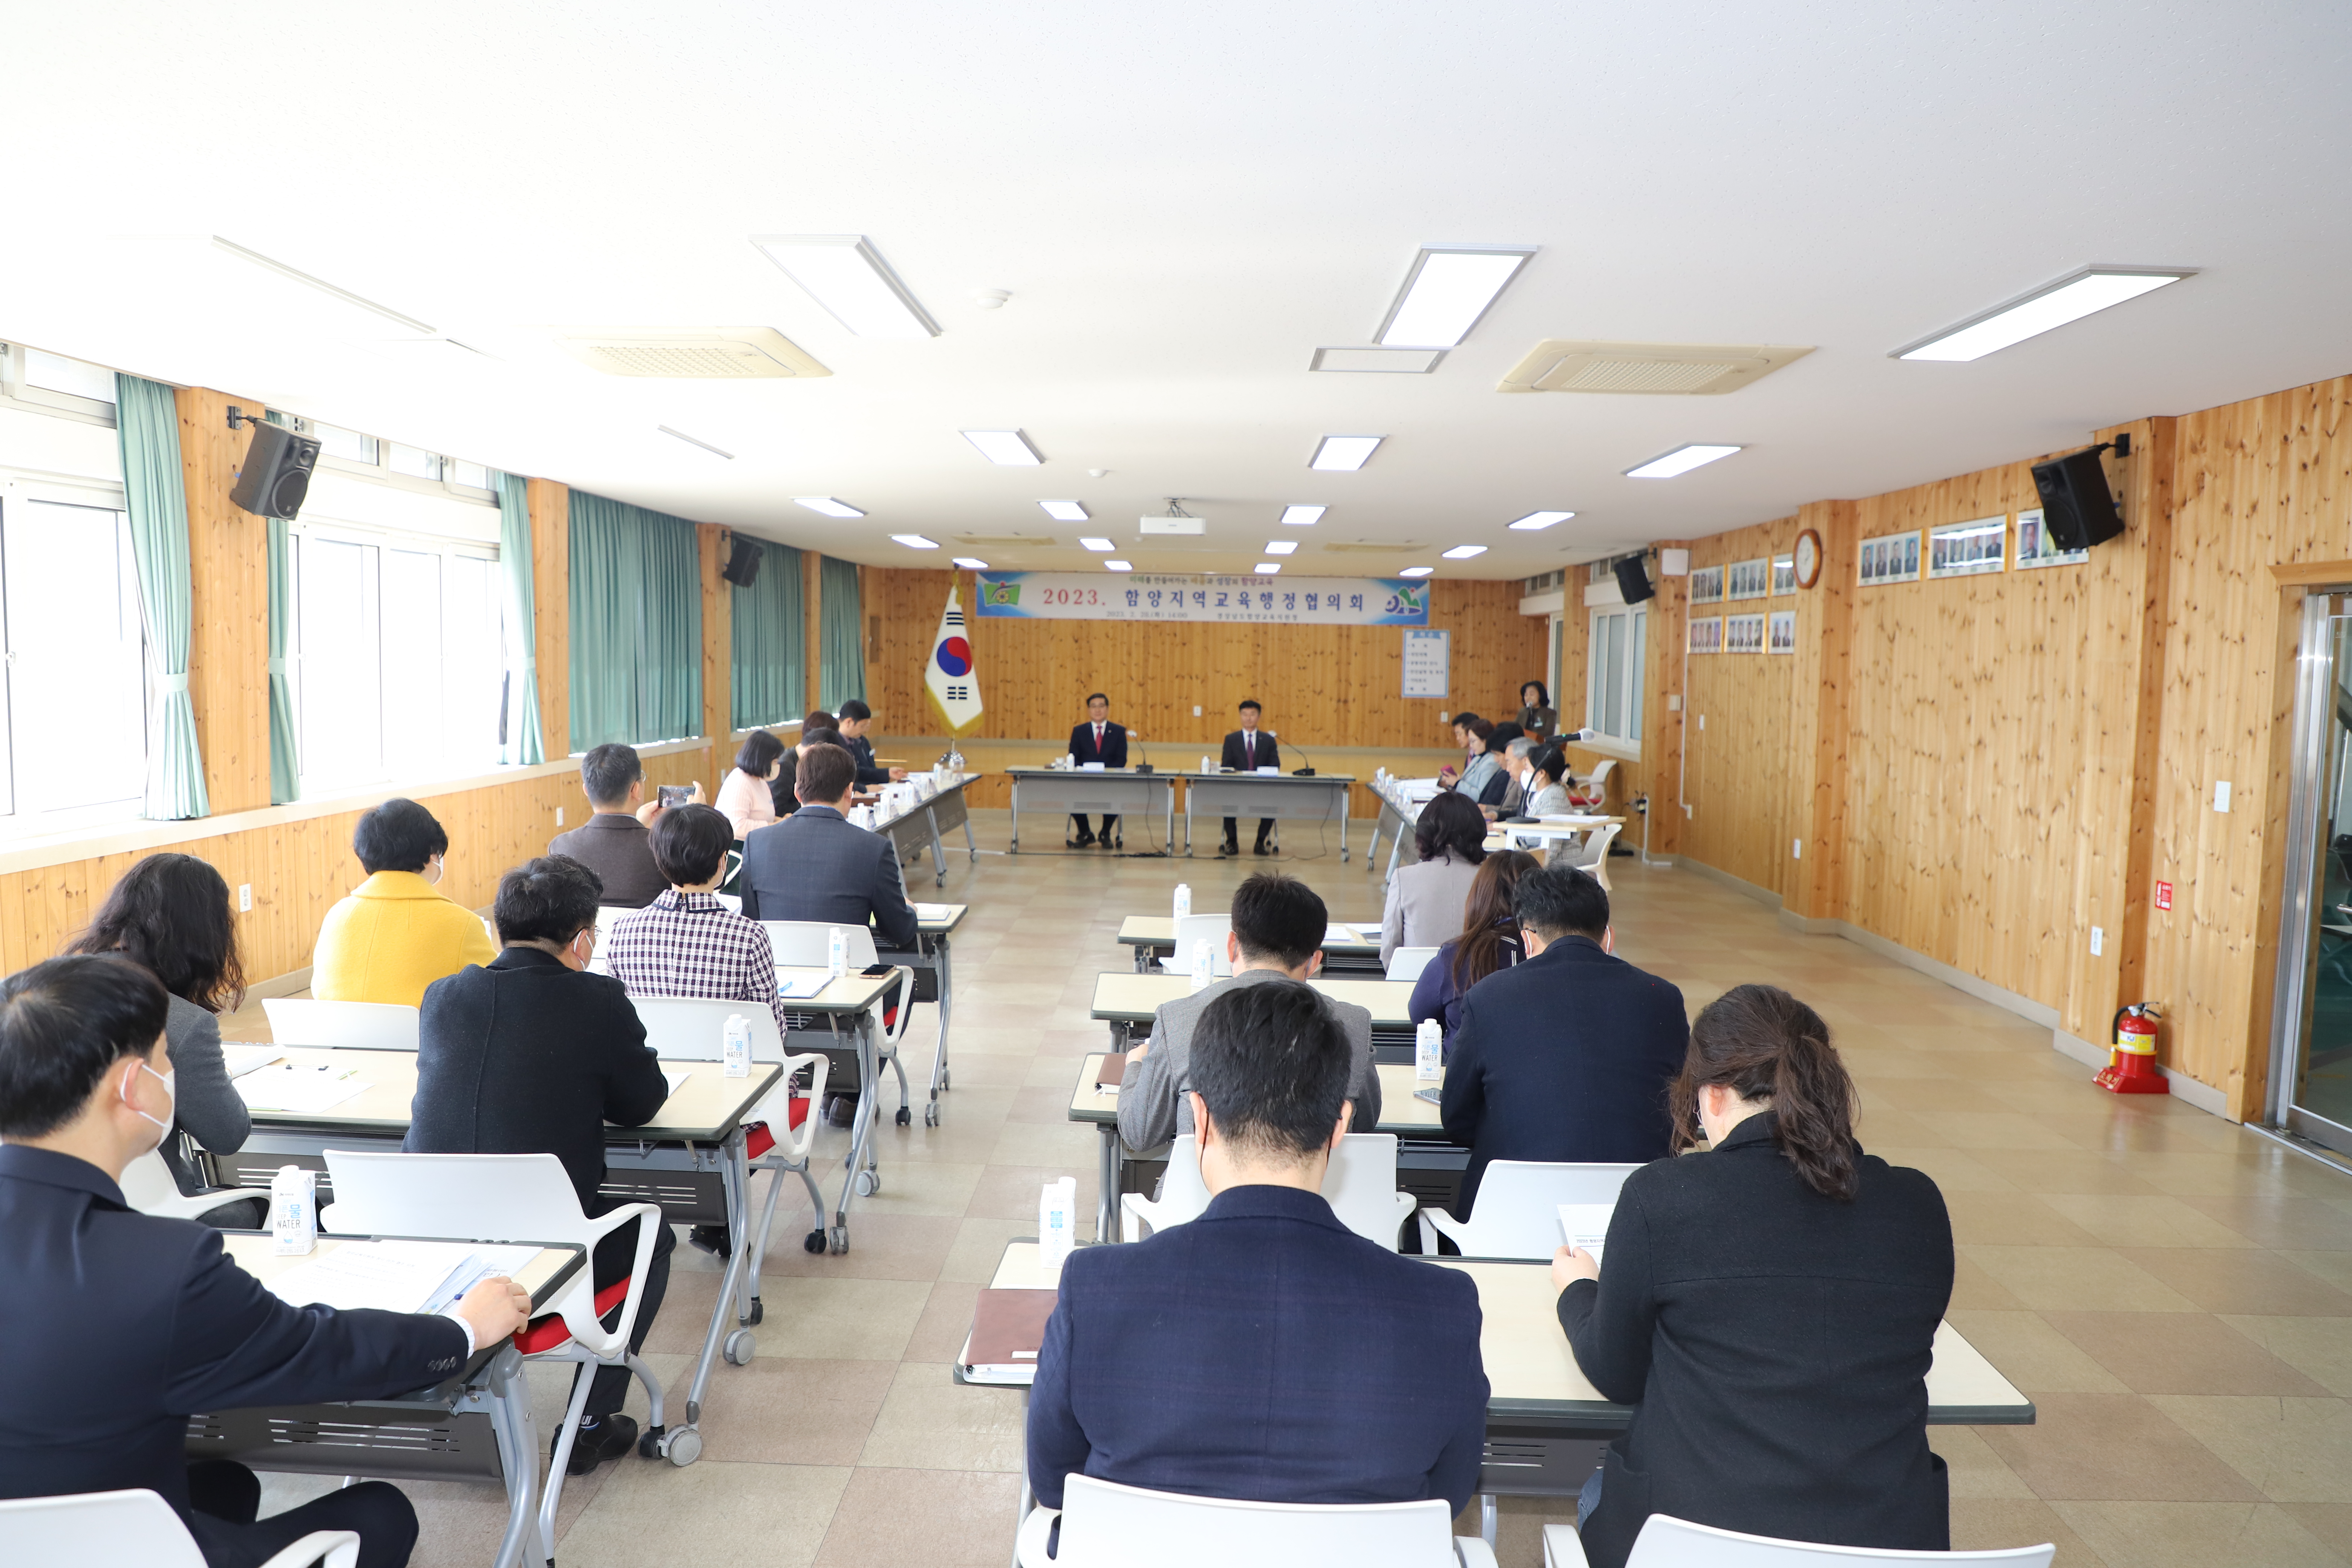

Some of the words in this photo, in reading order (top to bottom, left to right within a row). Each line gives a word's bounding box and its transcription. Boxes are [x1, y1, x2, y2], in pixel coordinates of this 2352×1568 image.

[1043, 588, 1106, 606] 2023.
[1125, 589, 1364, 612] 함양지역교육행정협의회
[277, 1219, 300, 1229] WATER
